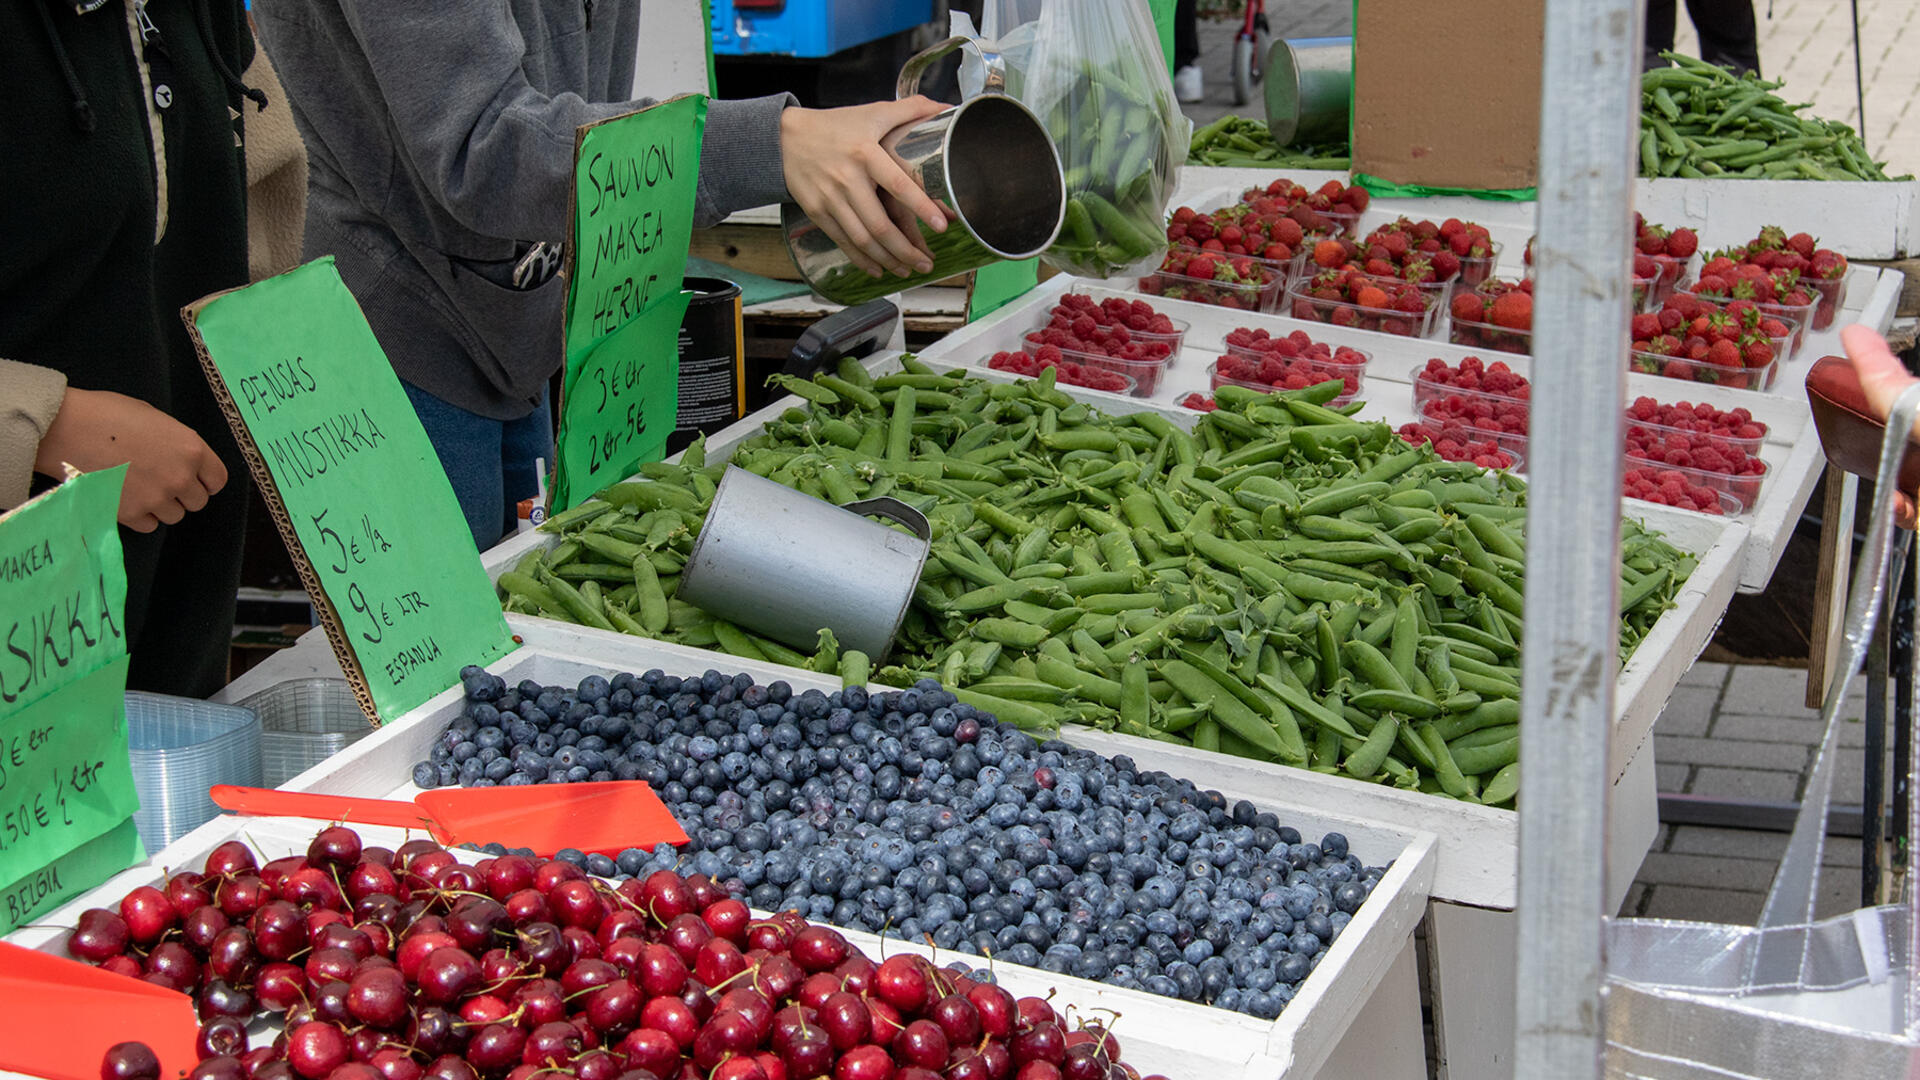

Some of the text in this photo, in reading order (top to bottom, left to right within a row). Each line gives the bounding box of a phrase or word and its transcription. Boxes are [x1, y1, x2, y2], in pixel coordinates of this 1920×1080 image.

[588, 136, 674, 218] SAUVON
[591, 210, 664, 280] MAKEA
[240, 356, 316, 421] PENSAS
[267, 408, 386, 488] MUSTIKKA
[395, 591, 430, 616] LTR
[385, 636, 442, 686] ESPANJA
